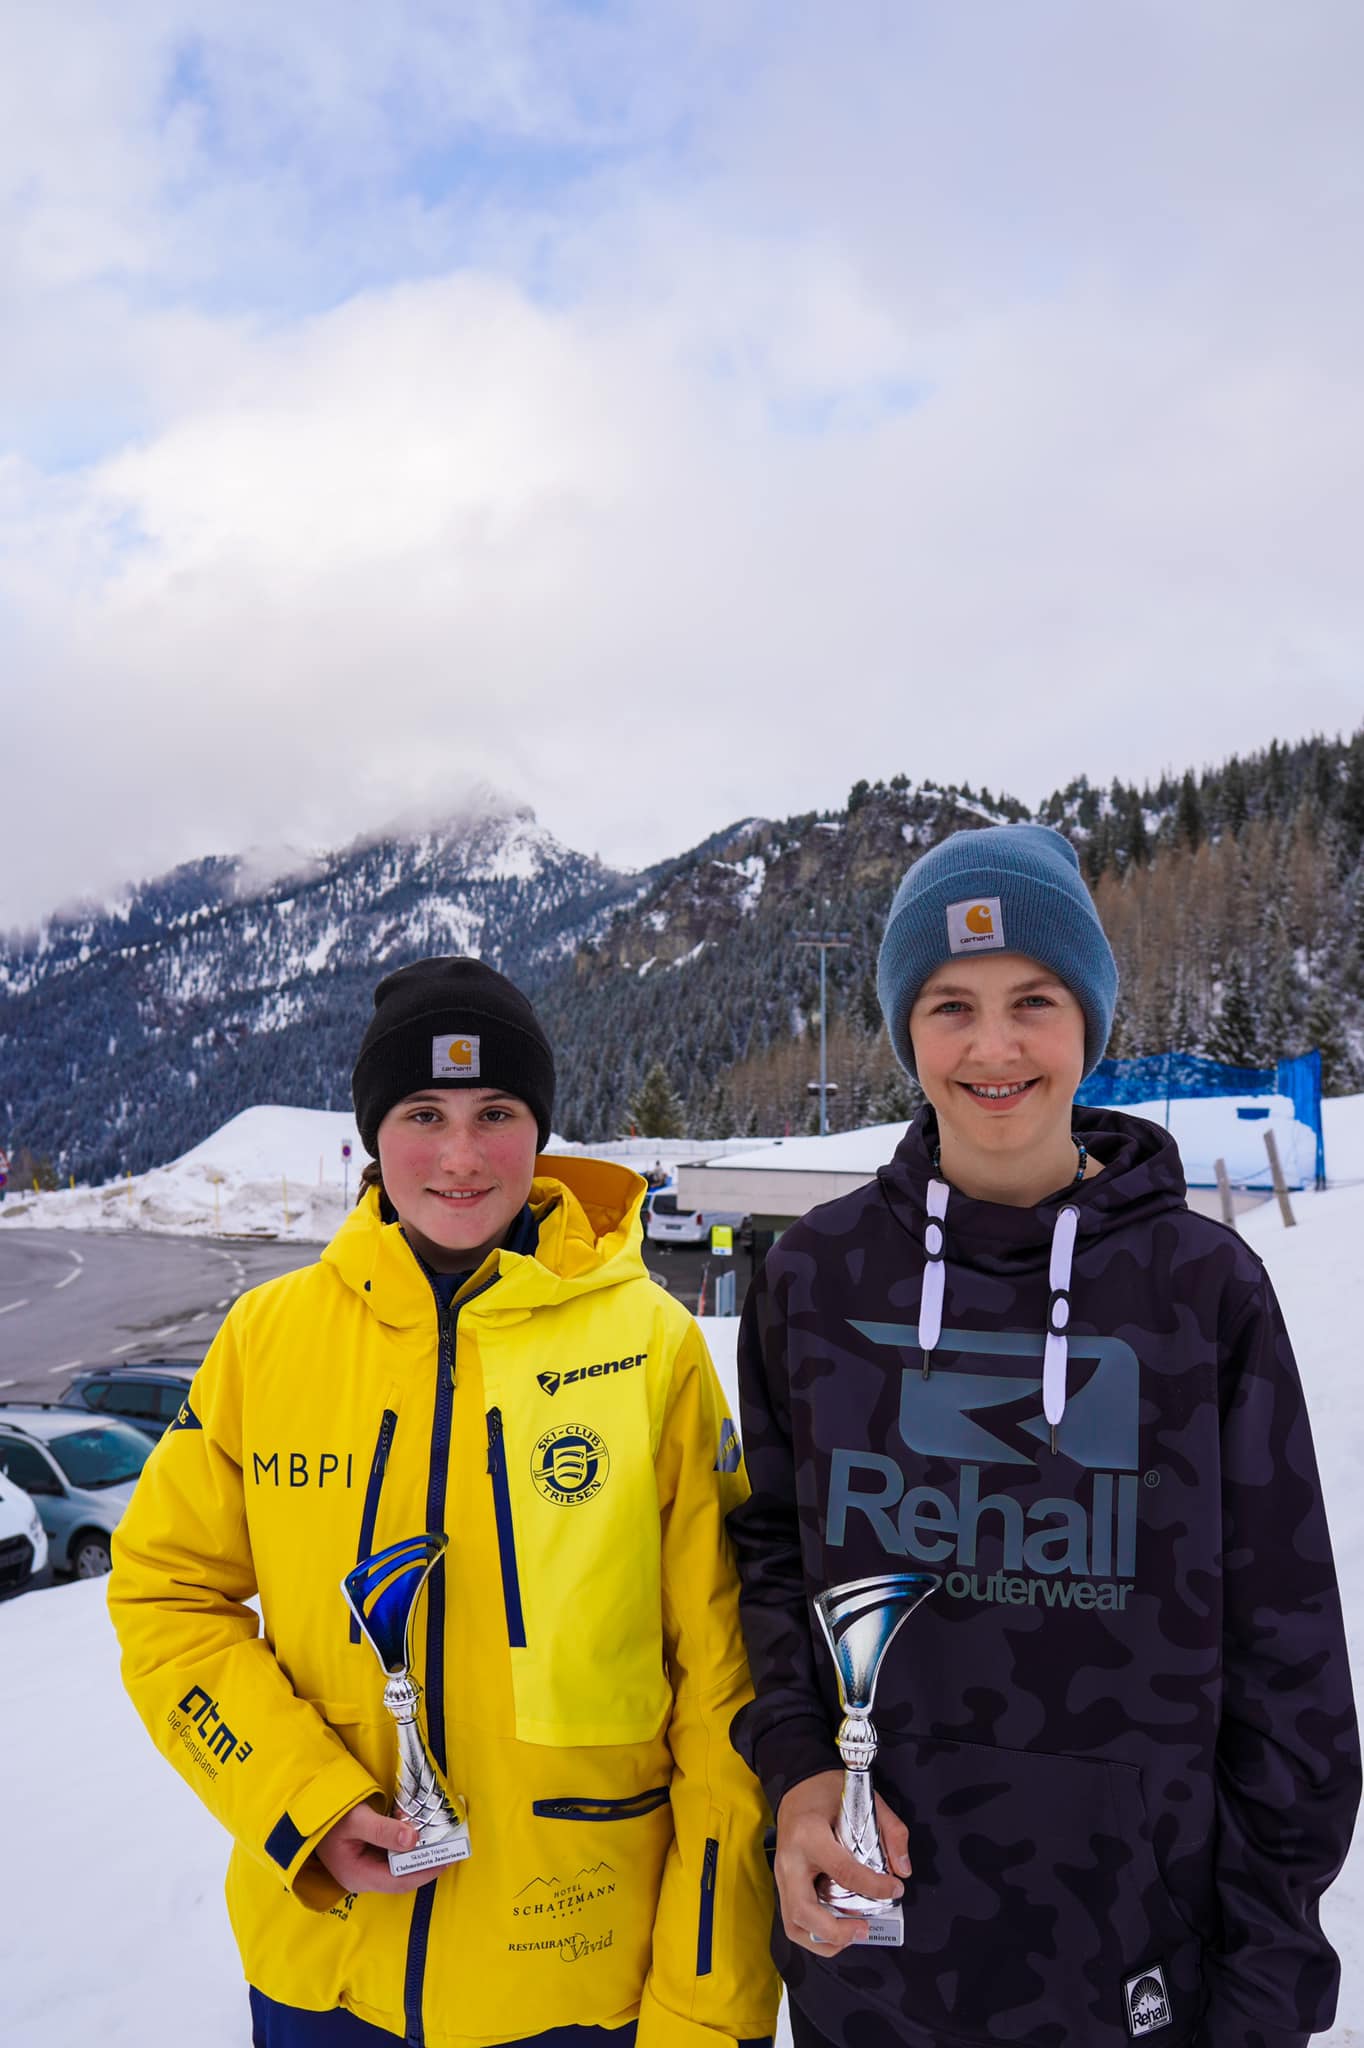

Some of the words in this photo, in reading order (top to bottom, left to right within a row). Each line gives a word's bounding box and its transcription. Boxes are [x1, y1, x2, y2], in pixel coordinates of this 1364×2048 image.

[563, 1353, 648, 1386] ziener
[537, 1425, 602, 1453] SKI-CLUB
[253, 1452, 352, 1489] MBPI
[543, 1480, 602, 1504] TRIESEN
[825, 1447, 1139, 1578] Rehall
[945, 1569, 1136, 1611] outerwear
[512, 1883, 617, 1917] SCHATZMANN
[553, 1883, 582, 1899] HOTEL
[508, 1935, 577, 1952] RESTAURANT
[562, 1929, 613, 1961] Vivid
